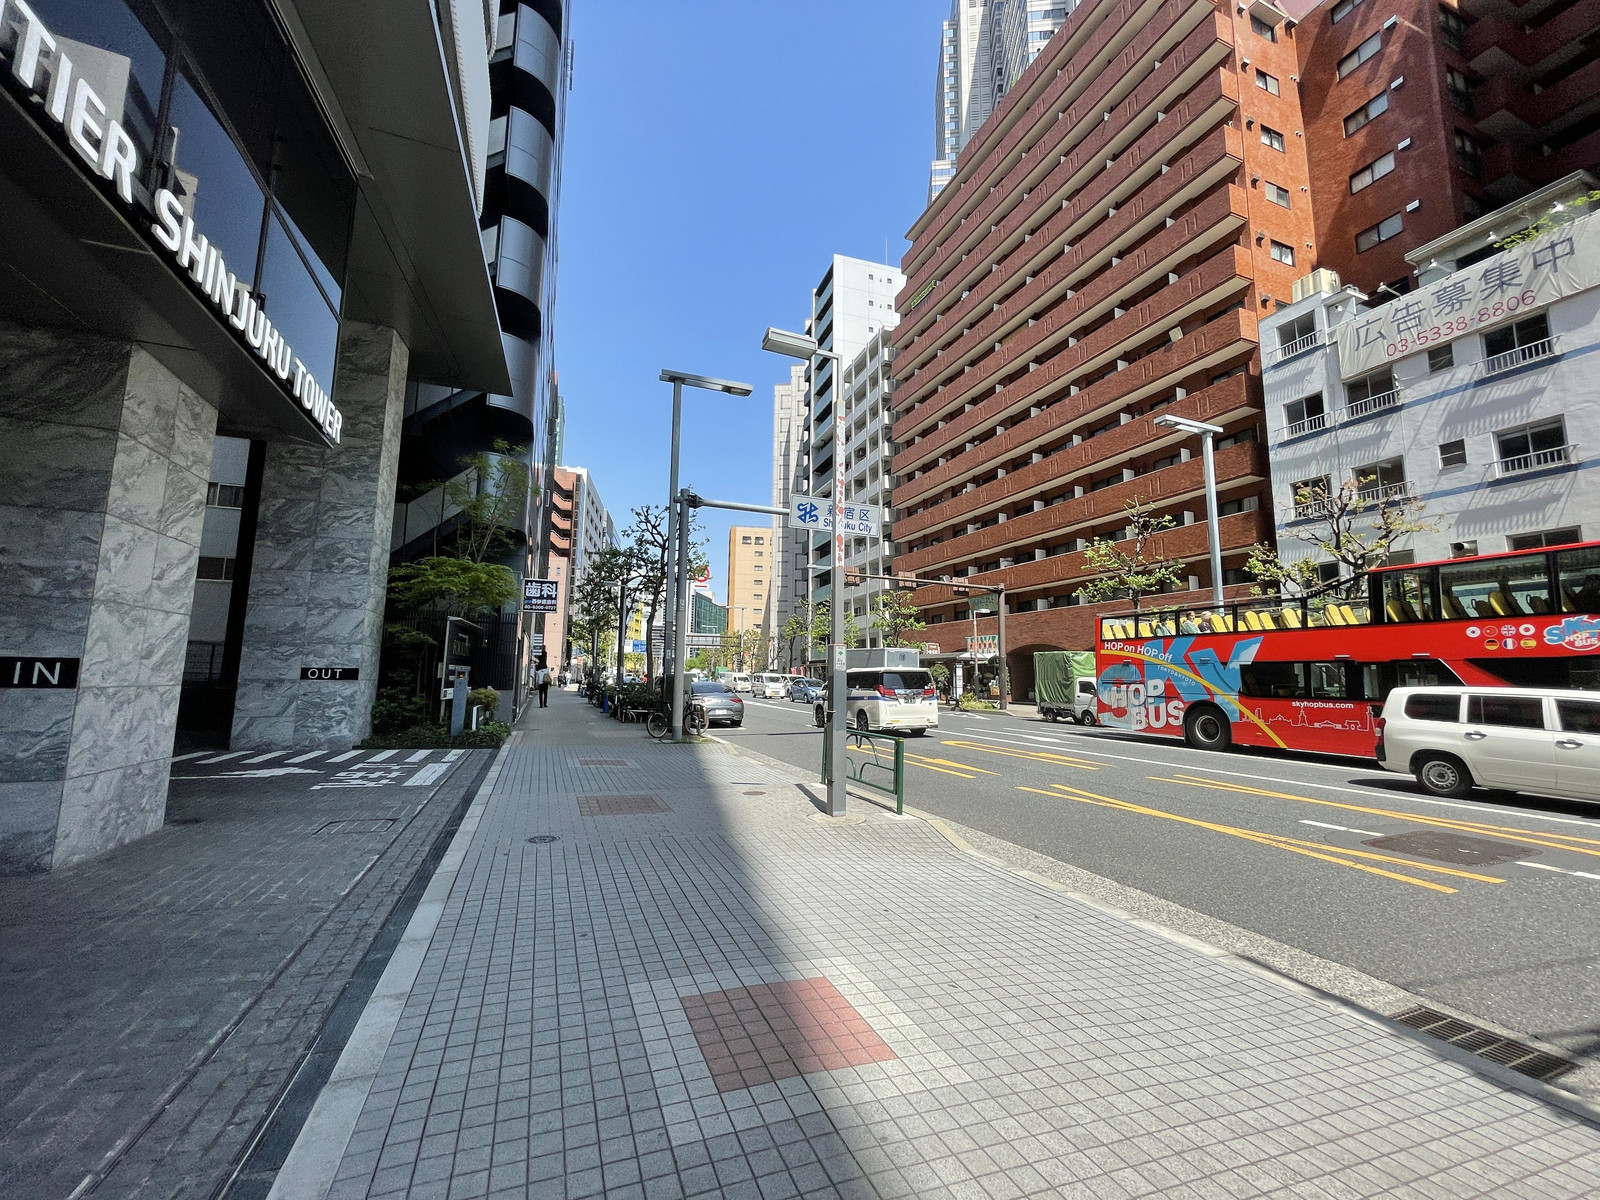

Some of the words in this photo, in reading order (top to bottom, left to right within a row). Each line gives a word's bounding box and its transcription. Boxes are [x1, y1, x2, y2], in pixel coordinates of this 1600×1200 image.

[0, 0, 137, 204] TIER
[153, 188, 292, 380] SHINJUKU
[292, 356, 342, 444] TOWER
[1354, 236, 1575, 352] 広告募集中
[1386, 289, 1536, 358] 03-5338-8806
[858, 522, 873, 534] City
[525, 582, 557, 598] 歯科
[1565, 632, 1590, 643] HOP
[1574, 637, 1598, 647] BUS
[1104, 641, 1123, 651] HOP
[1123, 644, 1135, 653] on
[1137, 645, 1159, 658] HOP
[1158, 652, 1173, 663] off
[12, 661, 62, 685] IN
[307, 667, 343, 680] OUT
[1110, 678, 1165, 709] HOP
[1291, 700, 1354, 709] skyhopbus.com
[1130, 700, 1185, 731] BUS
